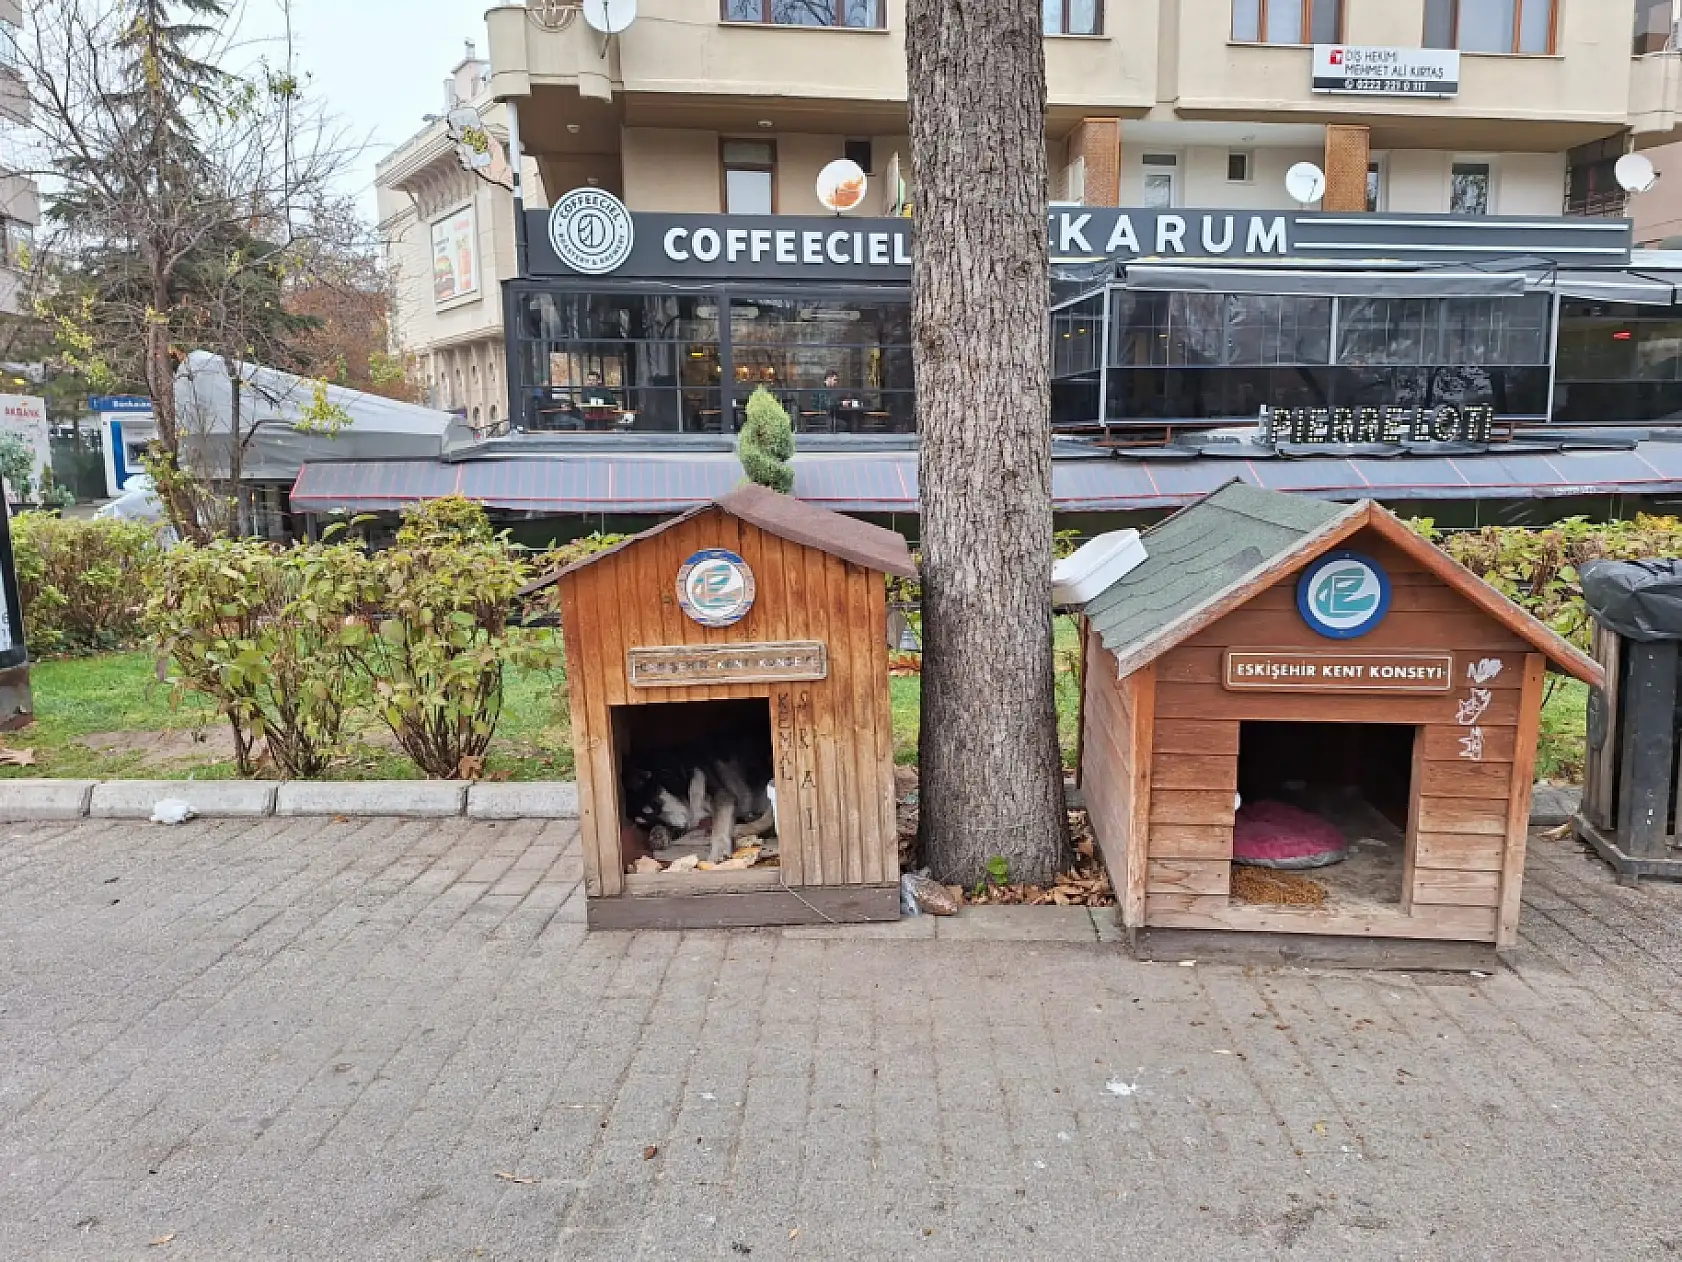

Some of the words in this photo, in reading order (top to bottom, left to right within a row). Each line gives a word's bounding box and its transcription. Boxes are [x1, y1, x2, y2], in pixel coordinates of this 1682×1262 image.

[1345, 64, 1389, 76] MEHMET
[1391, 64, 1406, 77] ALİ
[558, 193, 621, 222] COFFEECIEL
[664, 227, 911, 265] COFFEECIEL
[1059, 212, 1287, 255] KARUM
[1270, 405, 1404, 443] PIERRE
[1236, 659, 1317, 680] ESKİŞEHİR
[1322, 665, 1364, 679] KENT
[1369, 663, 1443, 681] KONSEYİ
